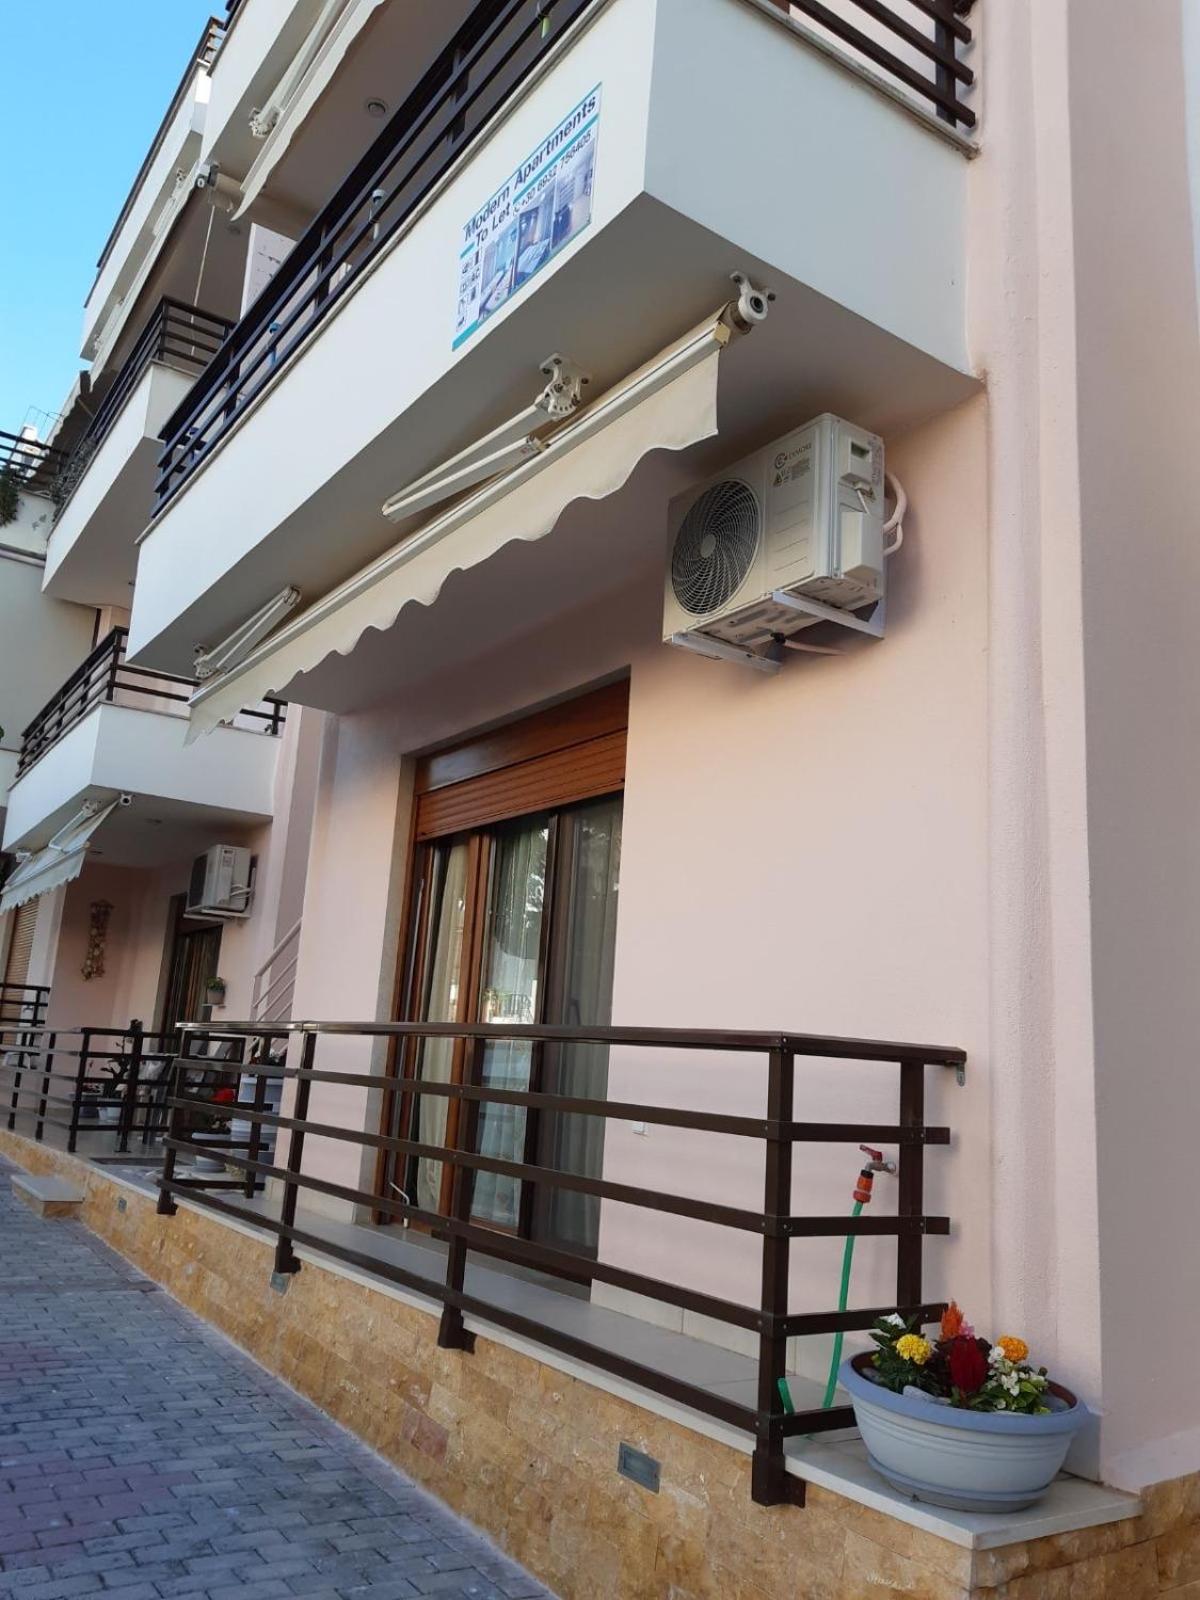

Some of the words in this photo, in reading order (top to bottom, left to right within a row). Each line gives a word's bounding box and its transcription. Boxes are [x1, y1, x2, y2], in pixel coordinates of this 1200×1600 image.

[465, 185, 510, 242] Modern
[514, 96, 596, 190] Apartments
[476, 229, 489, 247] To
[492, 203, 510, 230] Let
